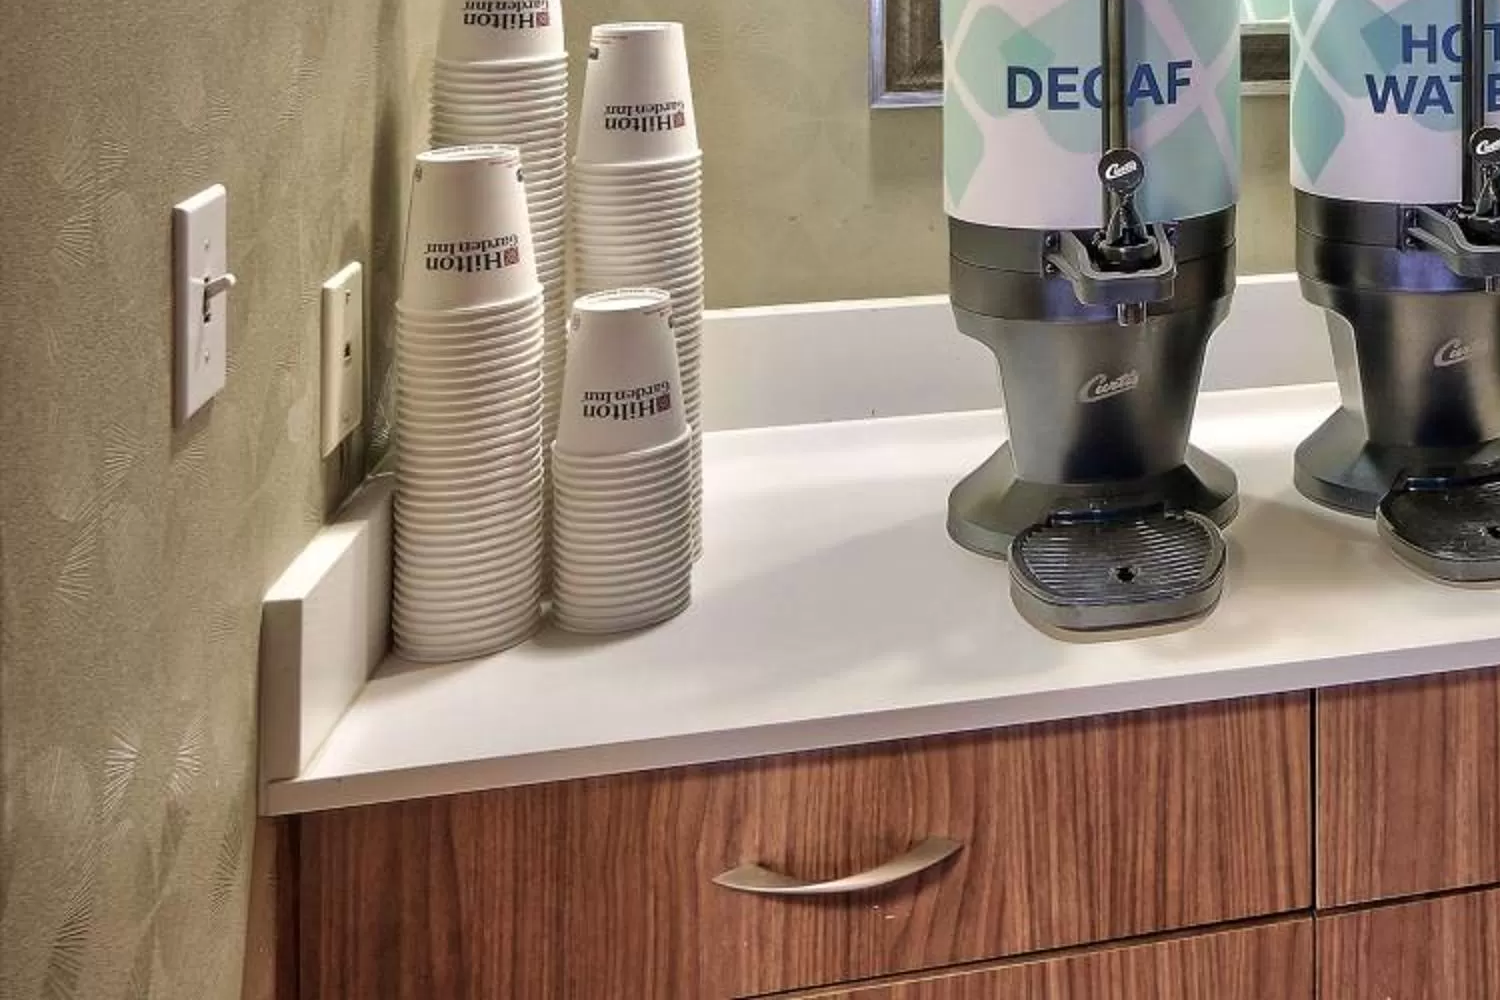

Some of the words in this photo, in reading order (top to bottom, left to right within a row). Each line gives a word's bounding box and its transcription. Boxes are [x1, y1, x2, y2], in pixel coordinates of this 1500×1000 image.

[463, 12, 535, 29] Hilton
[605, 114, 671, 132] Hilton
[426, 252, 502, 272] Hilton
[583, 398, 655, 420] Hilton
